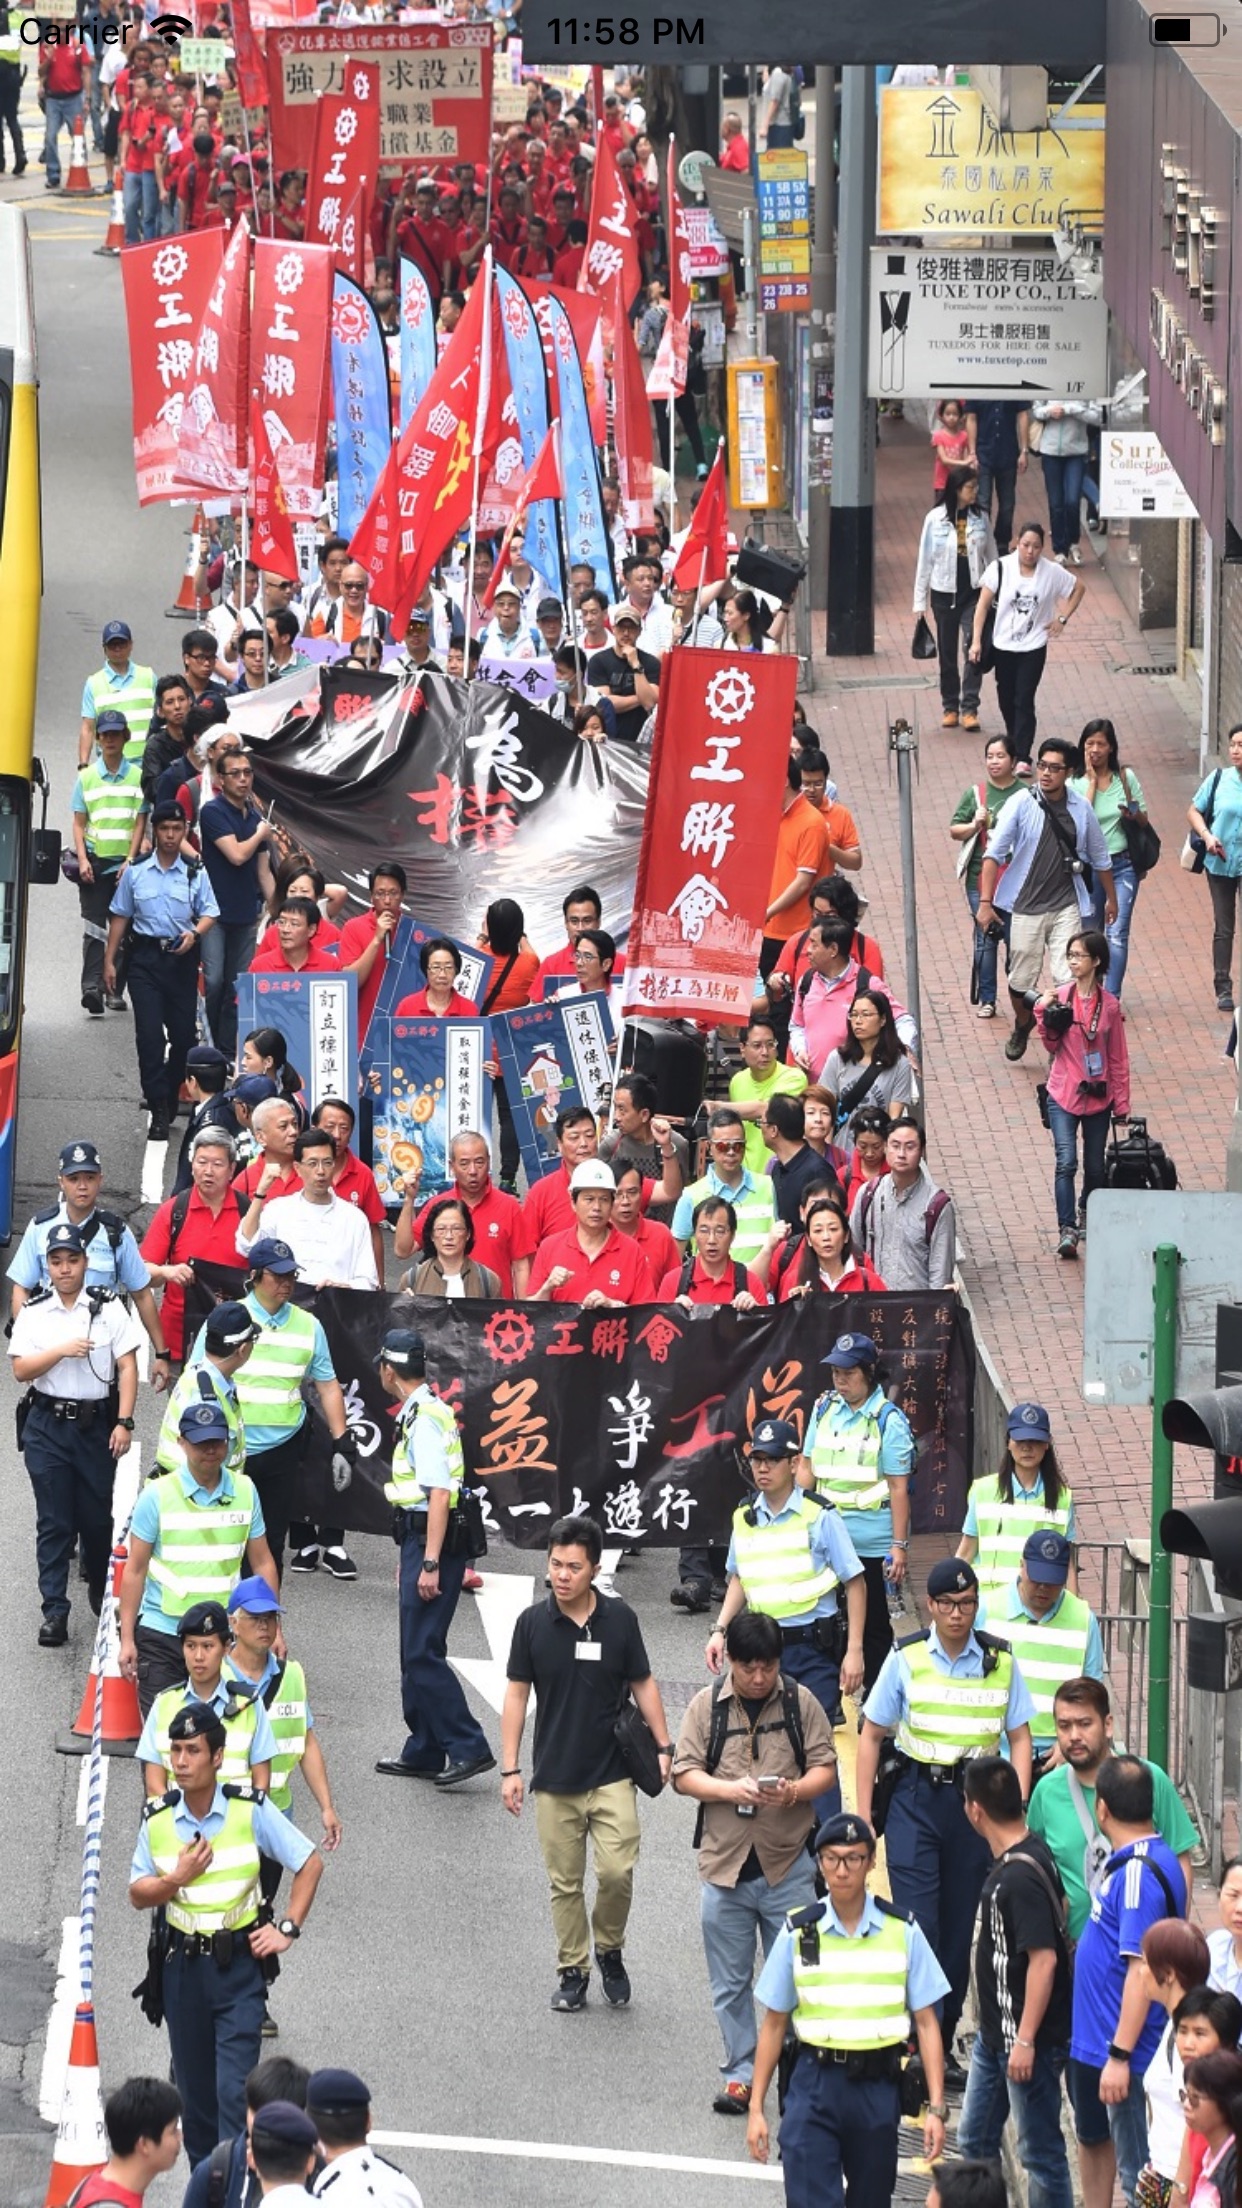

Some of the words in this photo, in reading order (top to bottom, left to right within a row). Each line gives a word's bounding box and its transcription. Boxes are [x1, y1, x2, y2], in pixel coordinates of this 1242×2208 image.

[286, 57, 479, 94] 強力求設立
[380, 103, 432, 124] 職業
[380, 129, 456, 155] 償基金
[765, 182, 771, 195] 1
[776, 181, 791, 194] 5B
[792, 181, 807, 193] 5X
[940, 165, 1055, 192] 泰國私房菜
[763, 196, 774, 208] 11
[794, 194, 806, 206] 40
[922, 199, 1005, 225] Sawali
[763, 209, 775, 221] 75
[777, 208, 791, 221] 90
[794, 207, 807, 219] 97
[916, 257, 1098, 283] 俊雅禮服有限公
[764, 285, 776, 297] 23
[796, 284, 808, 295] 25
[919, 284, 969, 300] TUXE
[973, 284, 1011, 300] TOP
[1016, 284, 1051, 302] CO.,
[764, 299, 776, 310] 26
[943, 302, 988, 312] Formalwear
[1022, 304, 1064, 313] accessories
[959, 323, 1051, 340] 男士禮服租售
[928, 341, 976, 350] TUXEDOS
[981, 341, 1001, 350] FOR
[1006, 341, 1031, 350] HIRE
[1035, 341, 1050, 351] OR
[1055, 342, 1081, 351] SALE
[957, 355, 1048, 367] www.tuxetop.com
[466, 711, 545, 802] 為
[667, 735, 745, 943] 工聯會
[319, 990, 338, 1097] 訂立標準工
[457, 1036, 472, 1134] 取消強積金對
[546, 1312, 684, 1365] 工聯會
[901, 1308, 918, 1434] 反對擴大輸
